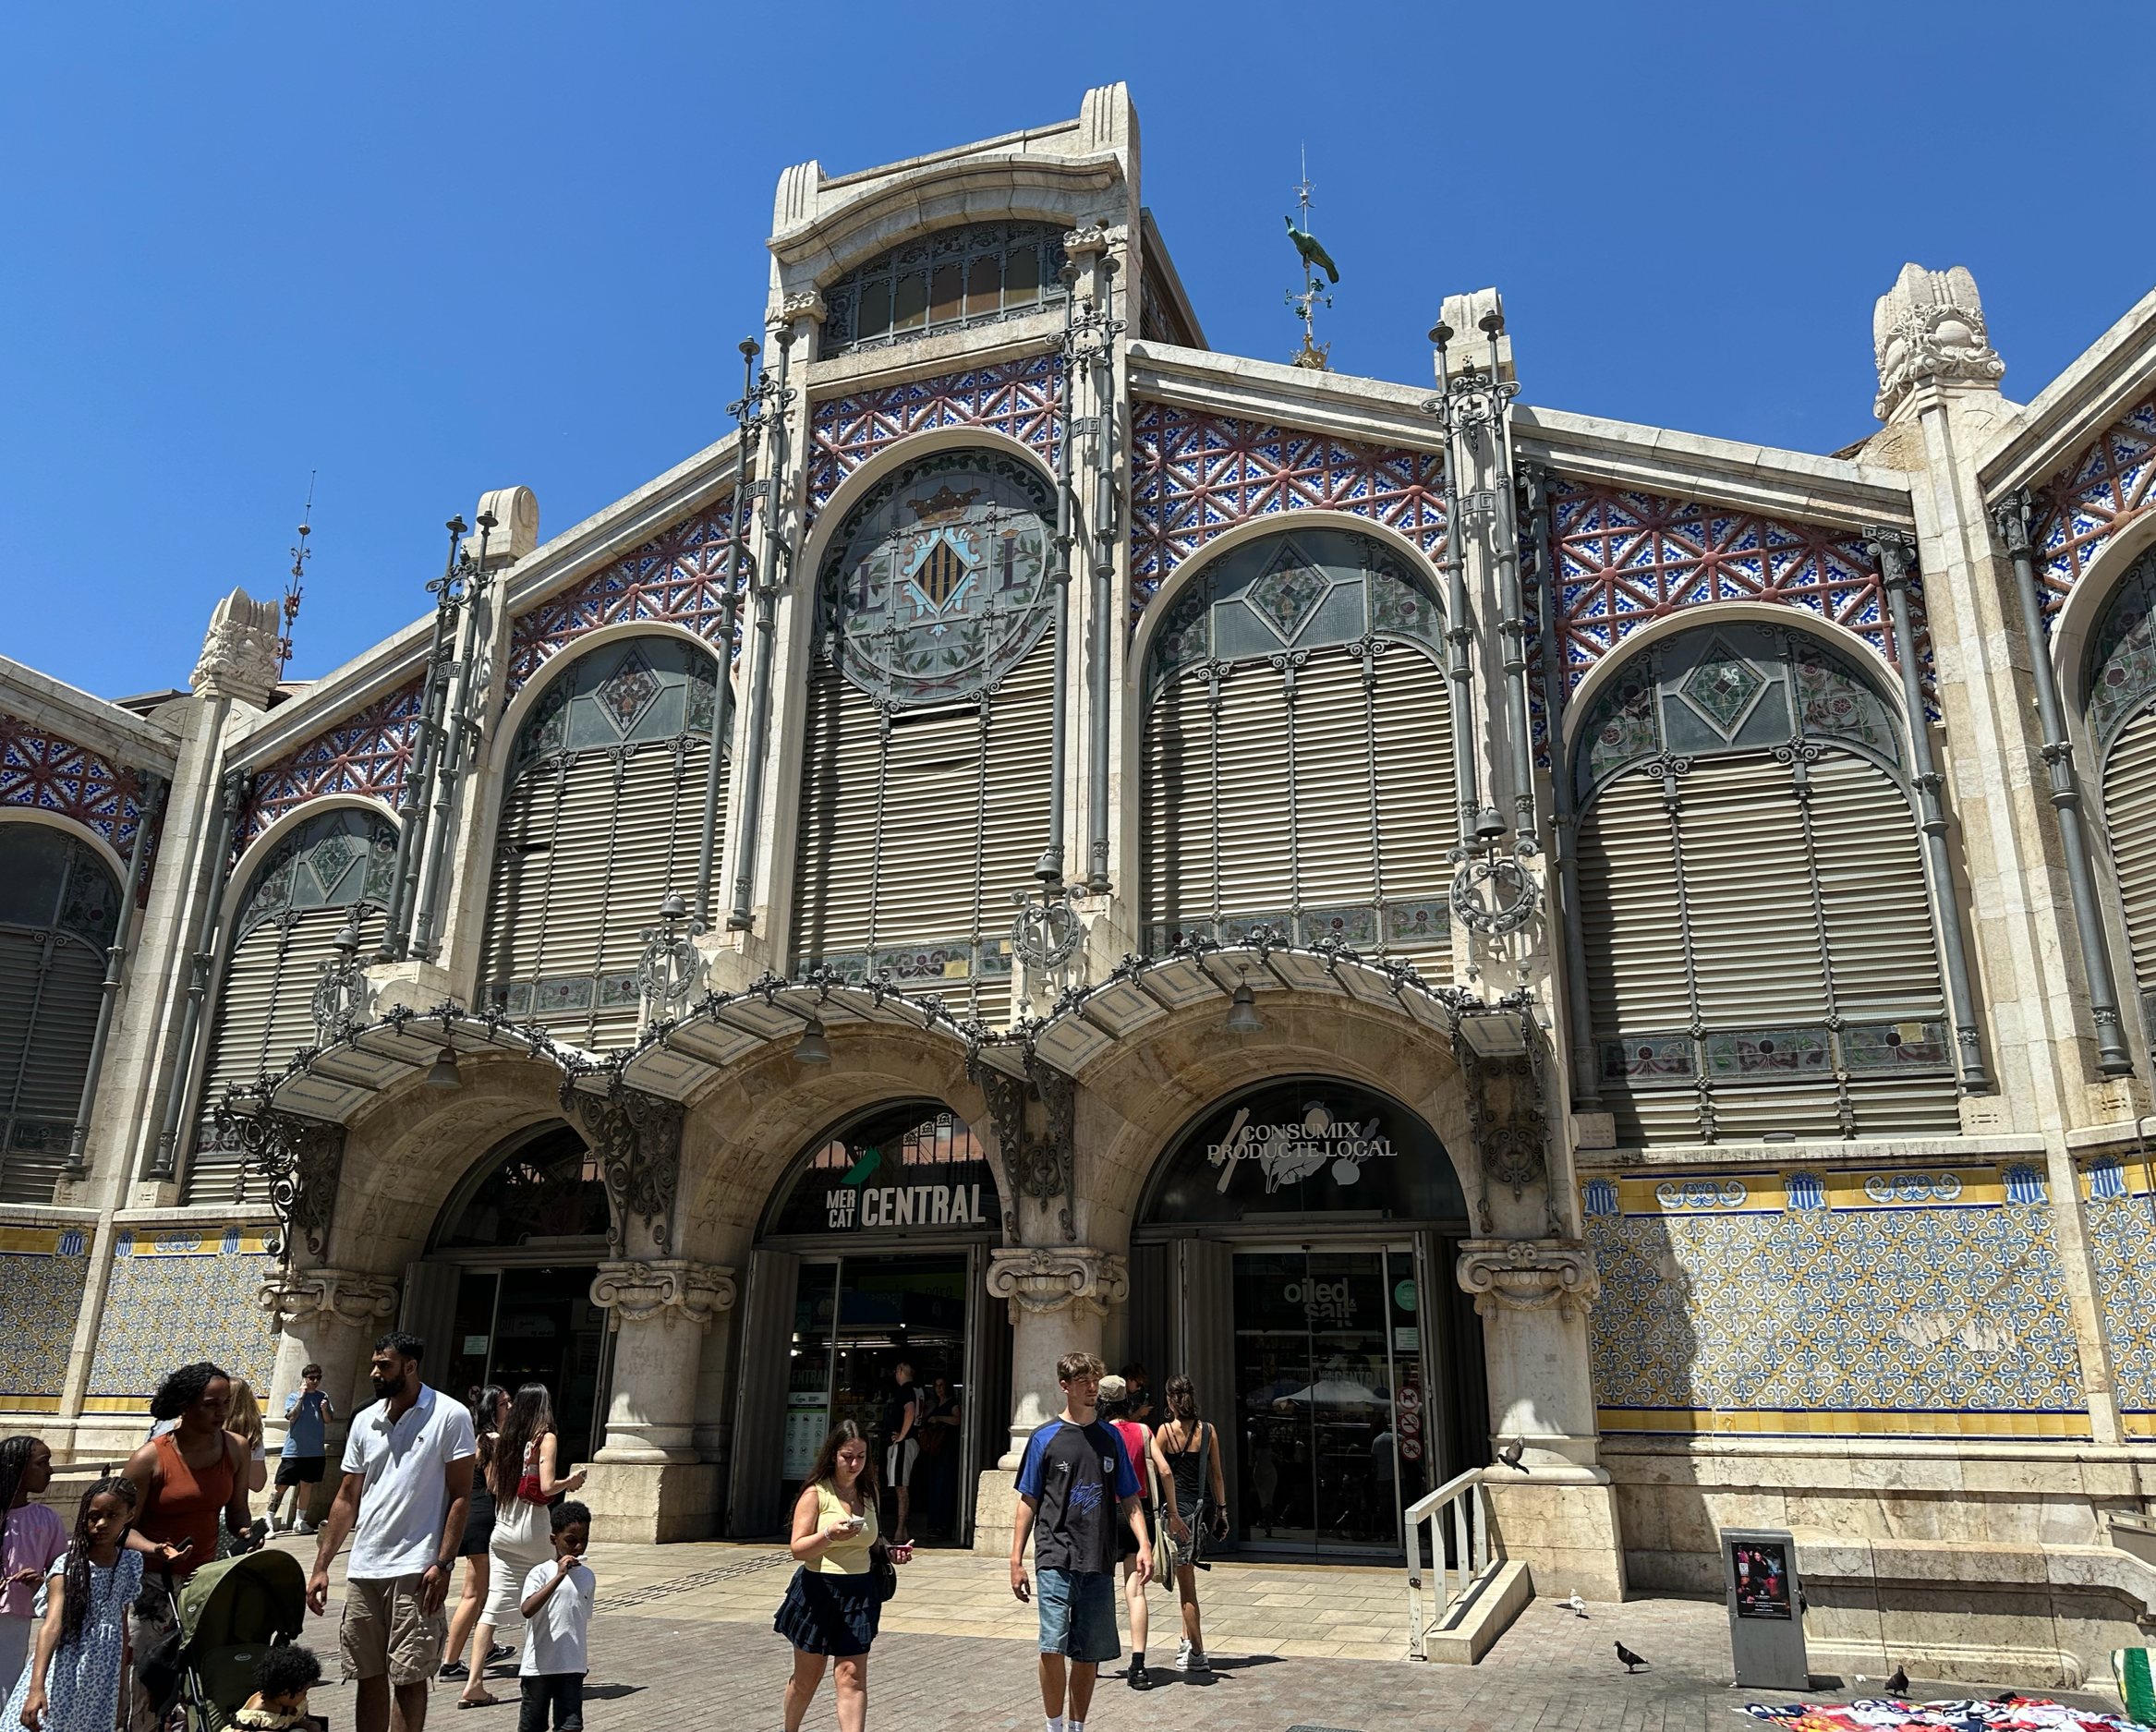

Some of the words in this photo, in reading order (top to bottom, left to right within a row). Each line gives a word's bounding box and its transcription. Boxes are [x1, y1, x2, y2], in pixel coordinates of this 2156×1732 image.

[1242, 1121, 1361, 1142] CONSUMIX
[1206, 1142, 1320, 1161] PRODUCTE
[1325, 1140, 1399, 1157] LOCAL
[826, 1189, 856, 1209] MER
[861, 1183, 987, 1227] CENTRAL
[829, 1208, 855, 1228] CAT
[1283, 1277, 1350, 1303] oiled
[1303, 1302, 1358, 1328] salt
